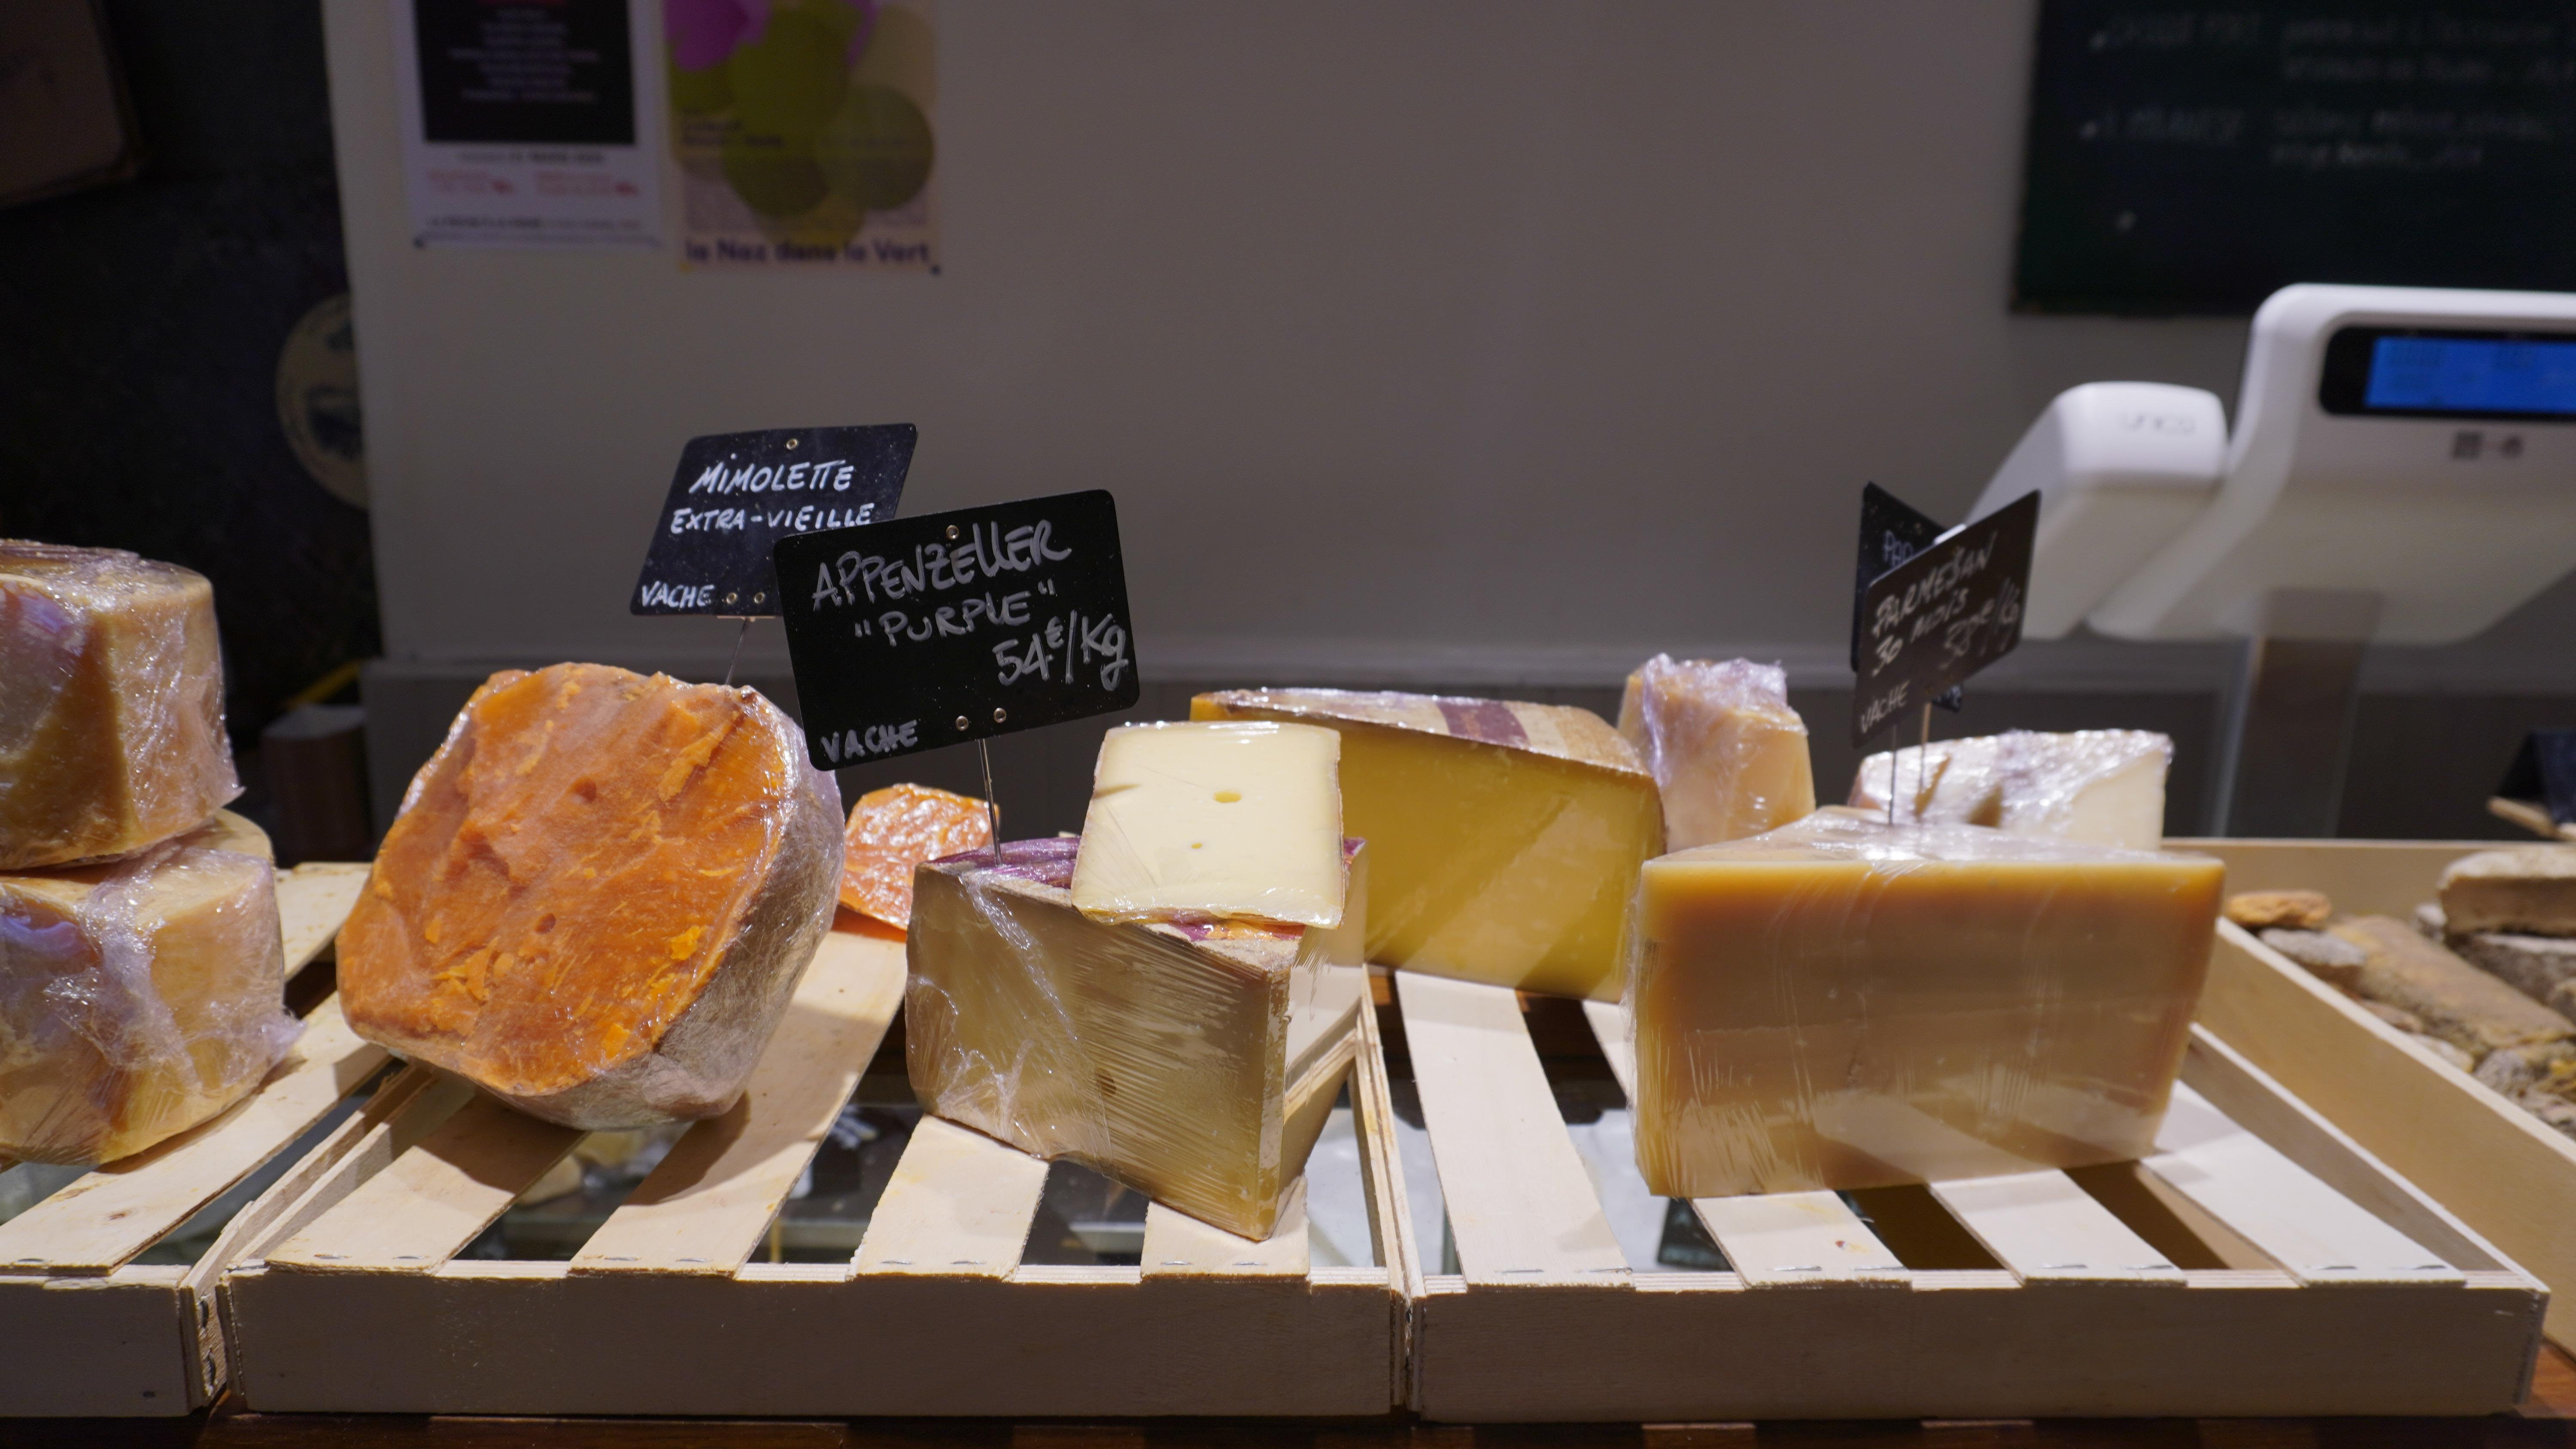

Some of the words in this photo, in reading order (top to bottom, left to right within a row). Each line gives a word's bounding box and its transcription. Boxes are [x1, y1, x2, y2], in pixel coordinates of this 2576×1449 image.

[670, 503, 875, 534] EXTRA-VIEILLE
[812, 519, 1072, 611] APPENZELLER
[1872, 530, 1998, 638] PARMESAN
[641, 580, 716, 609] VACHE
[1860, 679, 1910, 733] VACHE
[820, 719, 918, 764] VACHE
